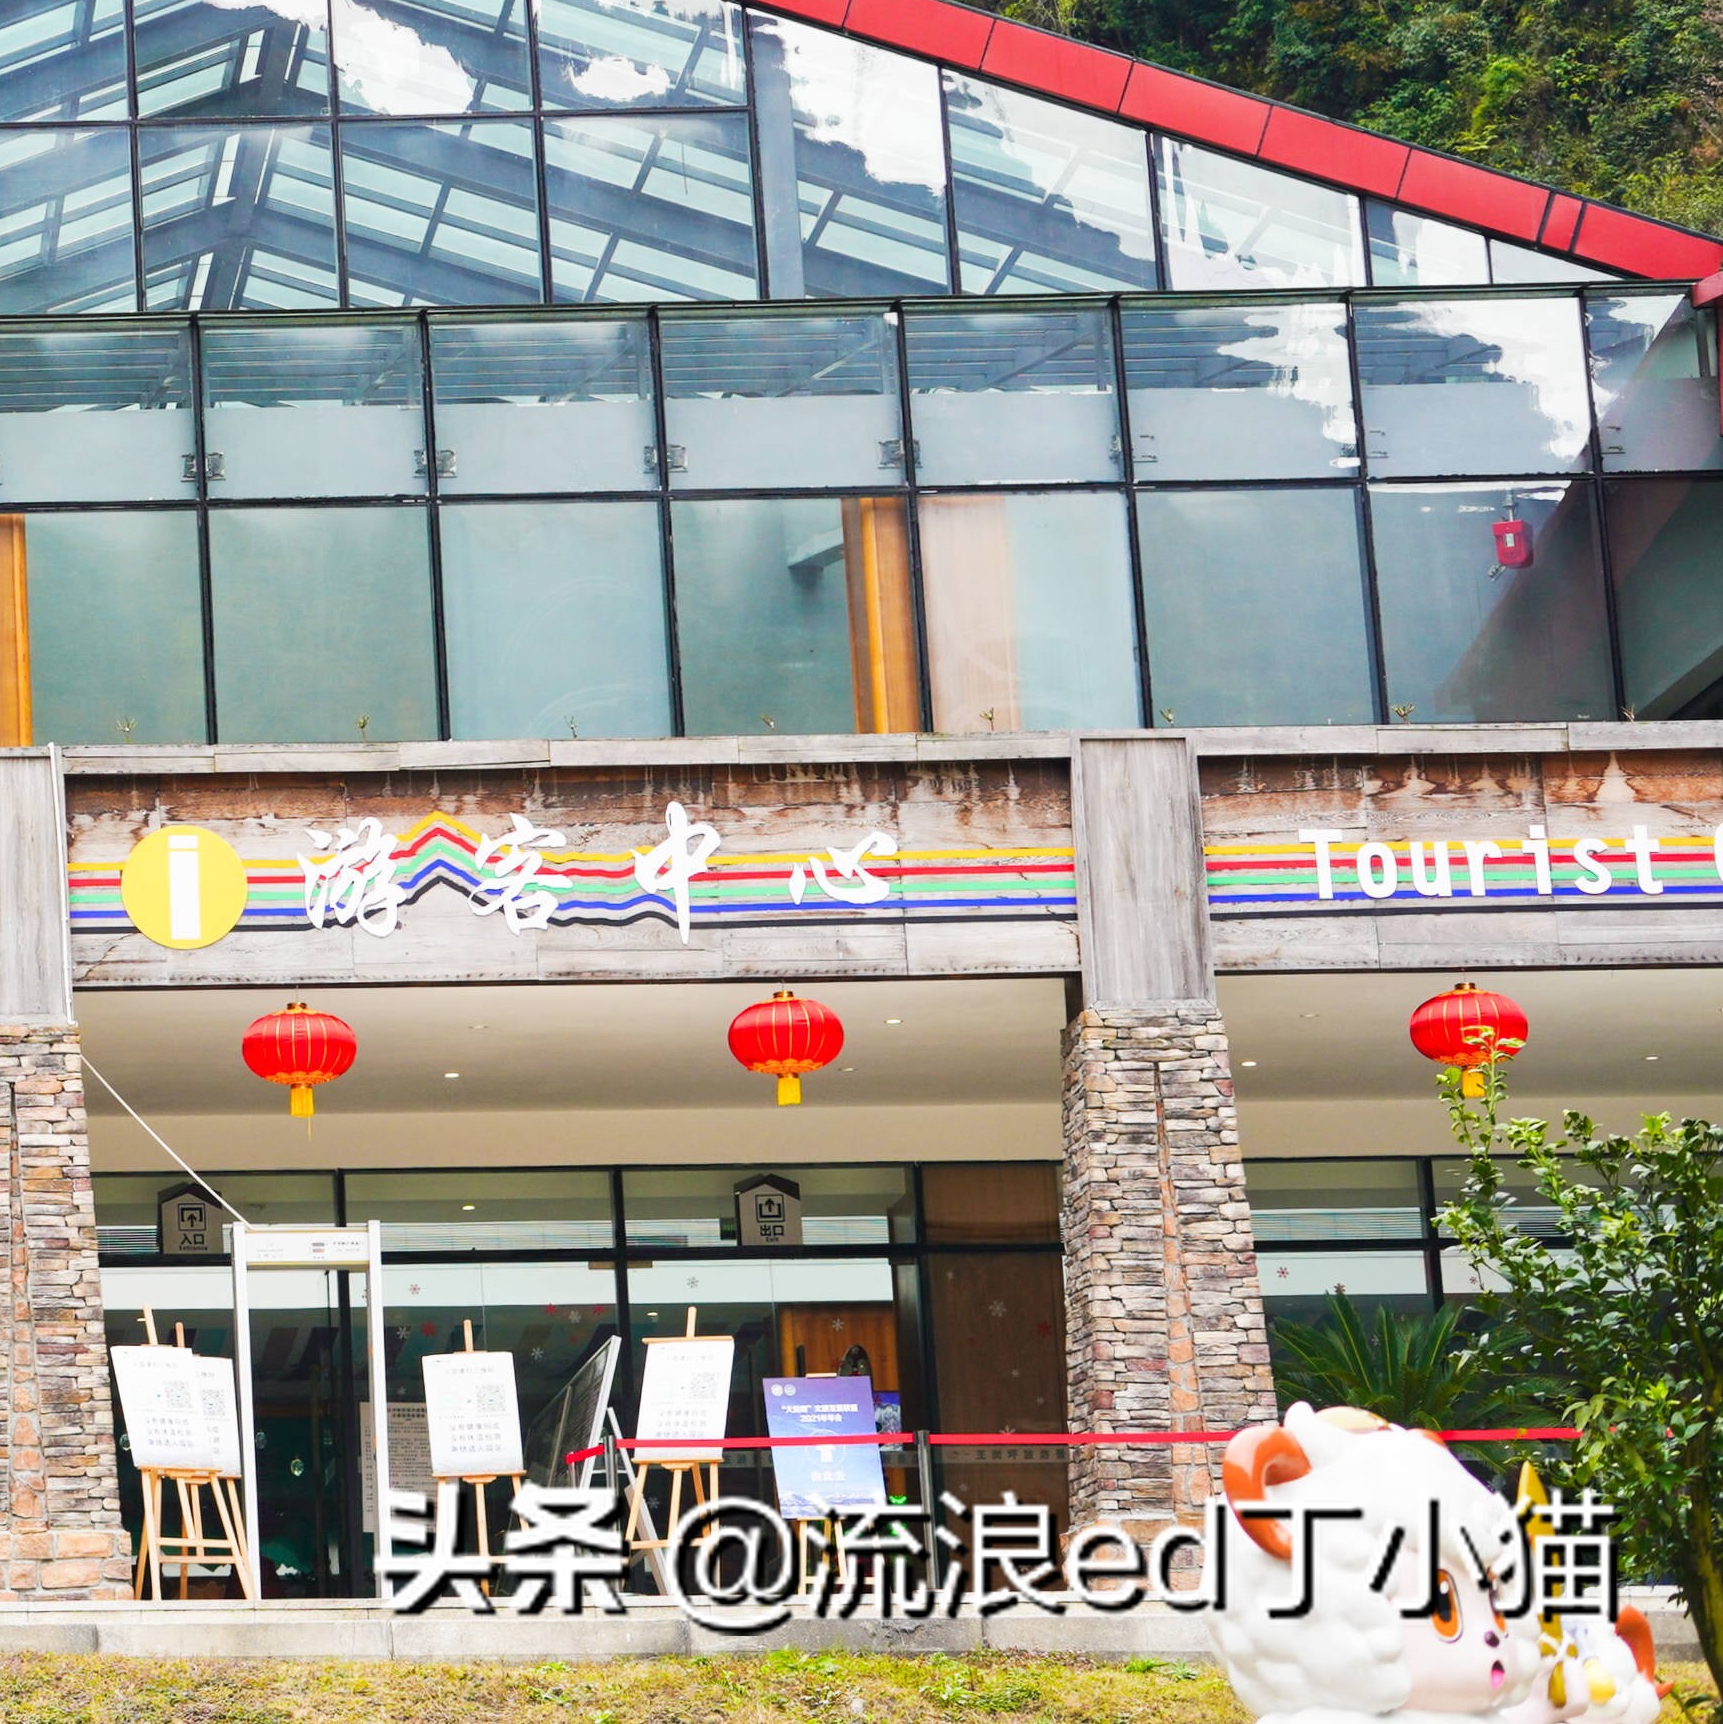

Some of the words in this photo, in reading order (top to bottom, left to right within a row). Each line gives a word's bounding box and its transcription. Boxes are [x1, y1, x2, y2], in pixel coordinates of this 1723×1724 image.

[298, 801, 898, 945] 游客中心
[1299, 824, 1664, 900] Tourist
[180, 1234, 205, 1245] 入口
[760, 1225, 784, 1236] 出口
